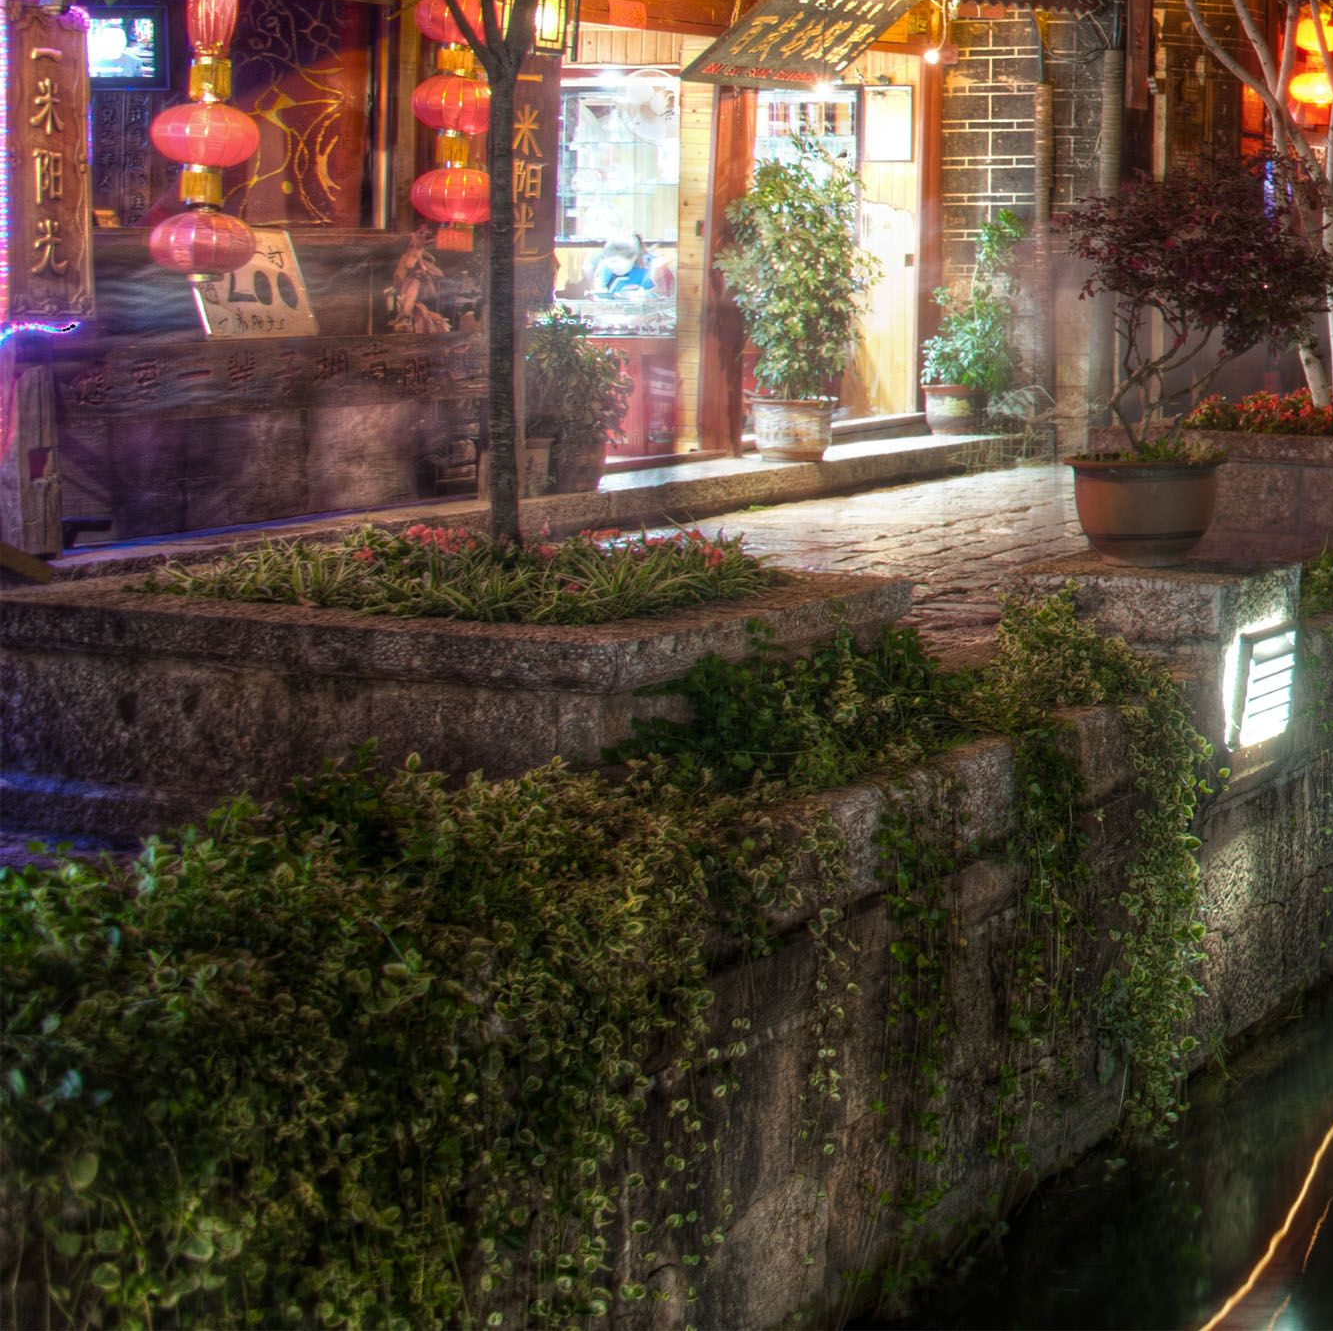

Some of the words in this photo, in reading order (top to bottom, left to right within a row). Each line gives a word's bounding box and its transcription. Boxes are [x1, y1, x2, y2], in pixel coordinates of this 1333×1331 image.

[31, 48, 68, 273] 一米阳光
[512, 74, 543, 254] 一米阳光
